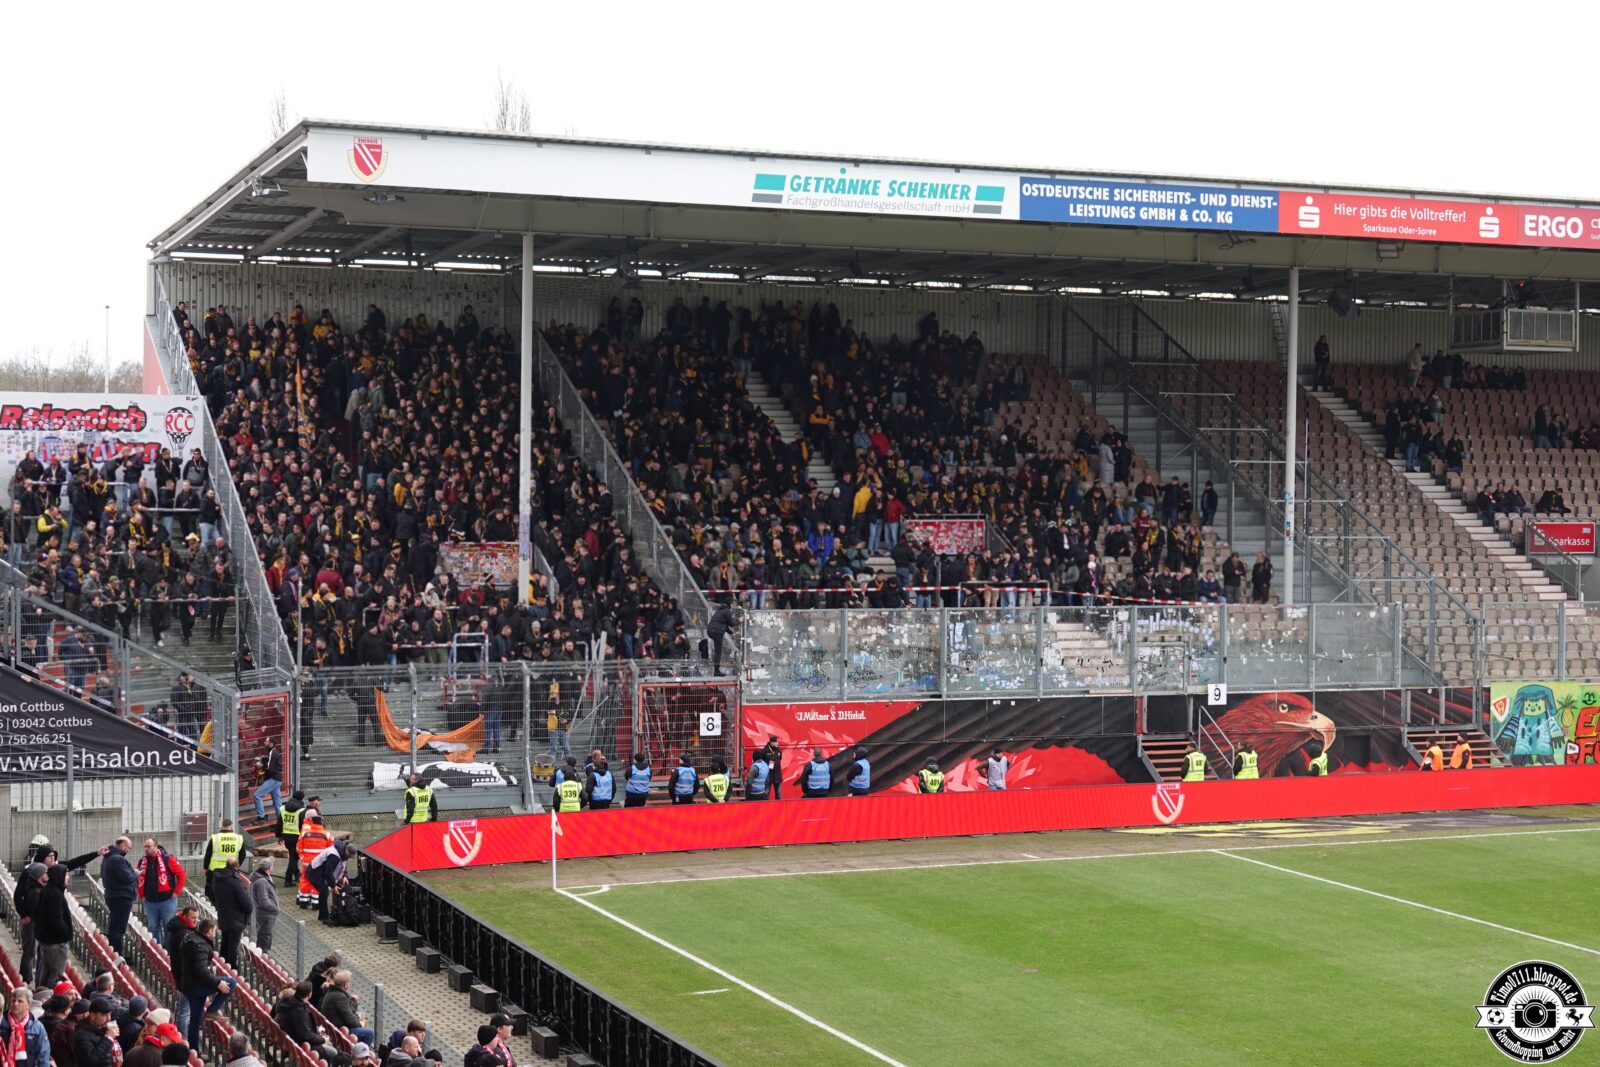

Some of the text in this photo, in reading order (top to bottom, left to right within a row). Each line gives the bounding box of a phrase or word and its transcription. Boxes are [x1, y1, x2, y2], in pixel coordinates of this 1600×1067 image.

[887, 179, 972, 201] SCHENKER
[1022, 183, 1278, 209] OSTDEUTSCHE SICHERHEITS- UND DIENST-
[786, 193, 971, 214] Fachgroßhandelsgesellschaft mbH
[1069, 203, 1233, 224] LEISTUNGS GMBH & CO. KG
[1334, 203, 1467, 223] Hier gibts die Volltreffer!
[1362, 223, 1437, 237] Sparkasse Oder-Spree
[1524, 214, 1584, 239] ERGO
[165, 413, 193, 433] RCC
[1214, 687, 1221, 701] 9
[20, 701, 65, 712] Cottbus
[12, 718, 46, 729] 03042
[48, 715, 93, 728] Cottbus
[8, 734, 27, 745] 756
[29, 733, 50, 744] 266
[52, 733, 72, 743] 251
[221, 843, 236, 853] 186
